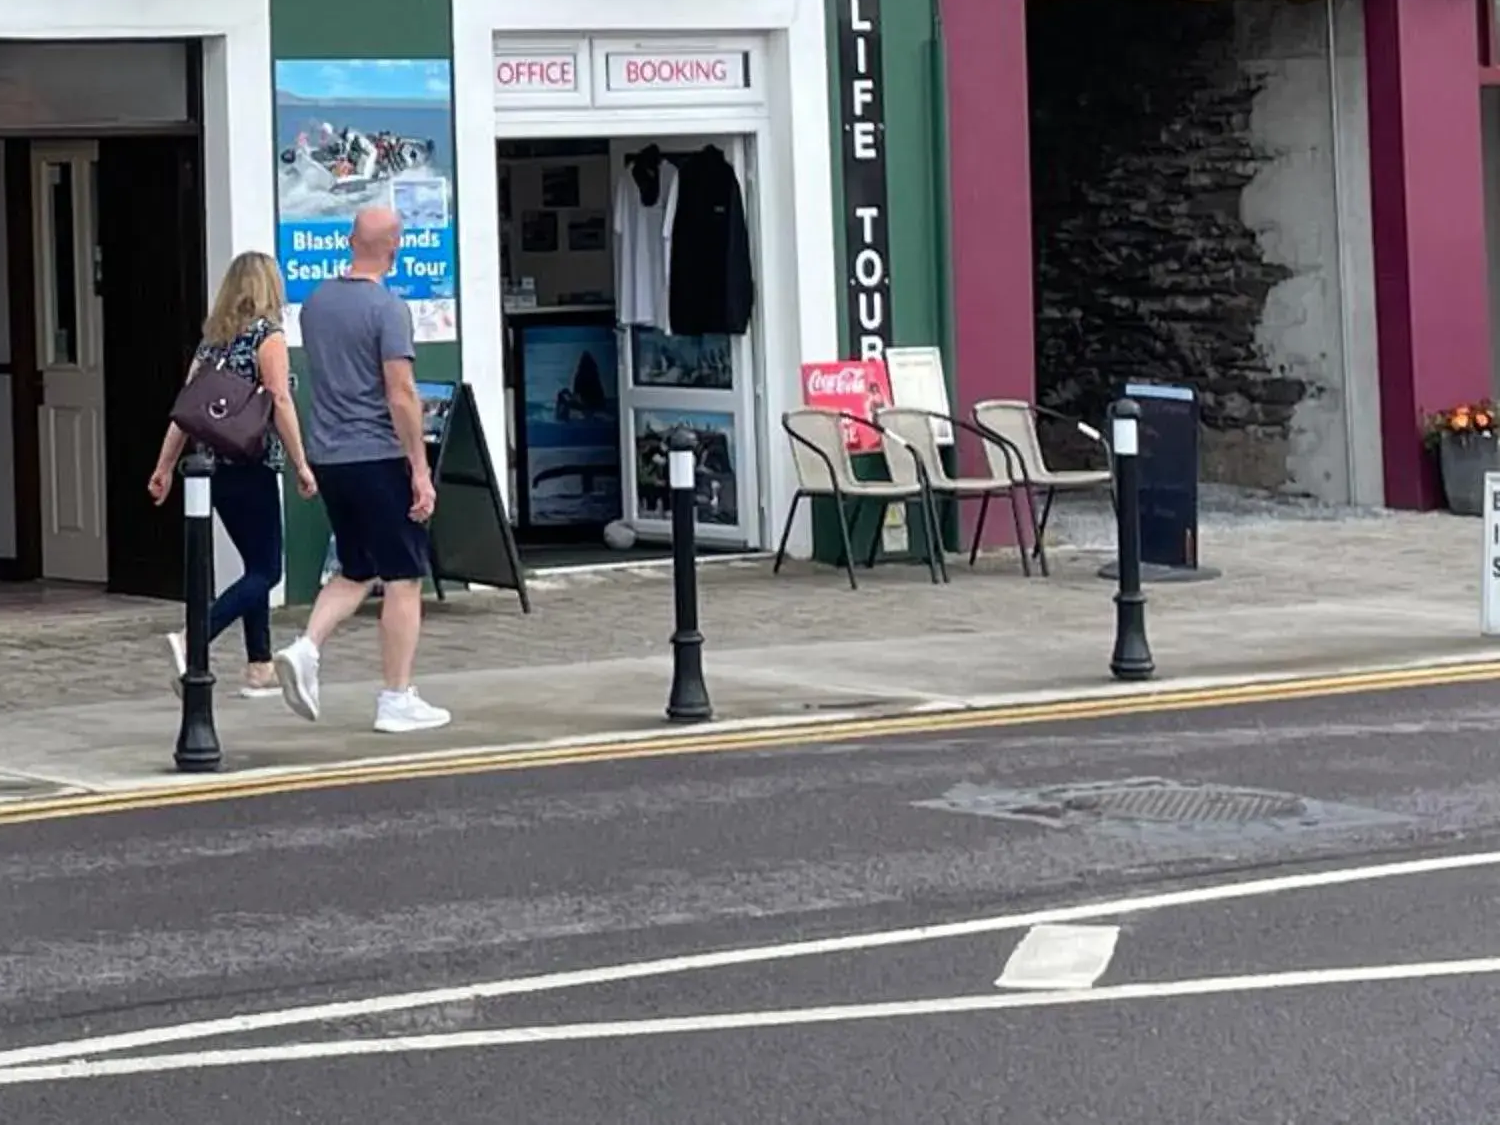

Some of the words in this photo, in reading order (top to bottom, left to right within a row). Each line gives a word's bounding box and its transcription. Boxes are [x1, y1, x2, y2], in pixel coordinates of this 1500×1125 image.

[496, 61, 572, 85] OFFICE
[625, 59, 727, 84] BOOKING
[293, 230, 351, 251] Blask
[403, 256, 447, 276] Tour
